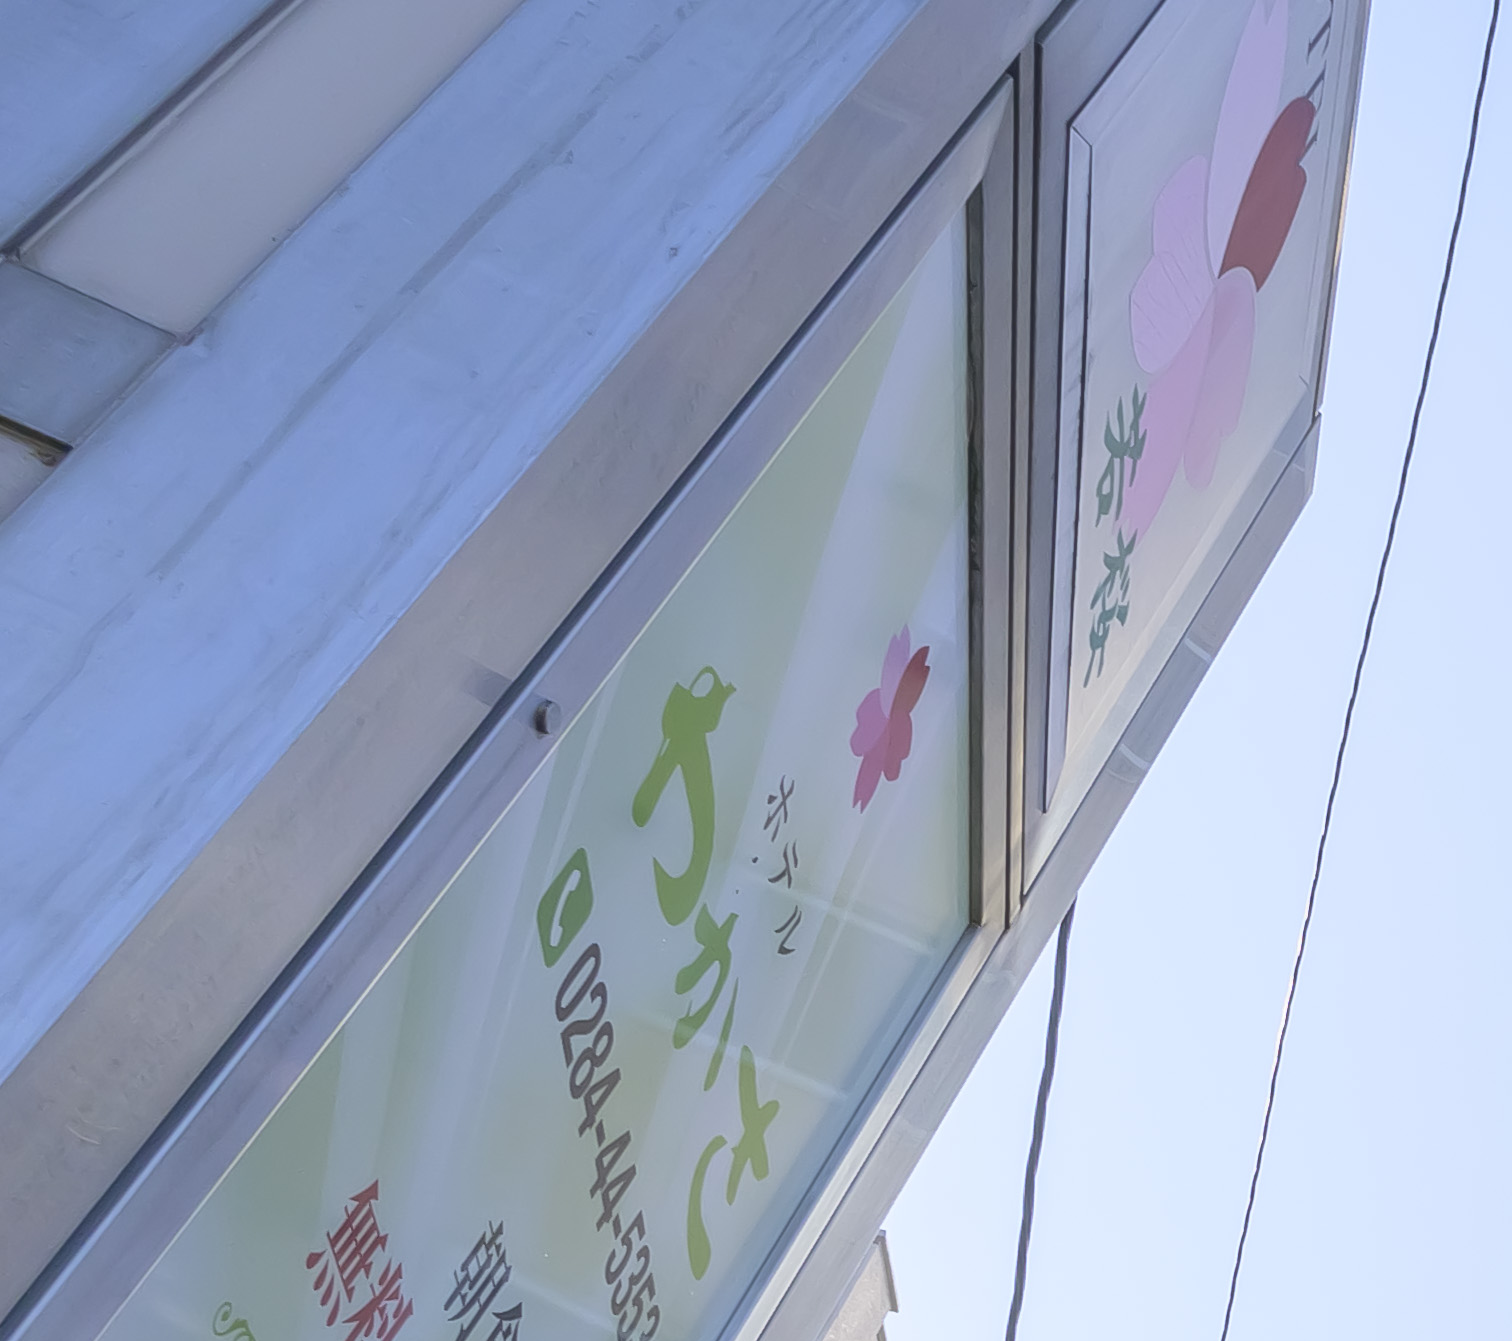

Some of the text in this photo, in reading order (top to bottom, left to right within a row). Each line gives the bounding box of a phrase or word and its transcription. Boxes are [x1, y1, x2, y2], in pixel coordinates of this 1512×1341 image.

[632, 665, 780, 1281] わかさ
[762, 774, 802, 955] ホテル
